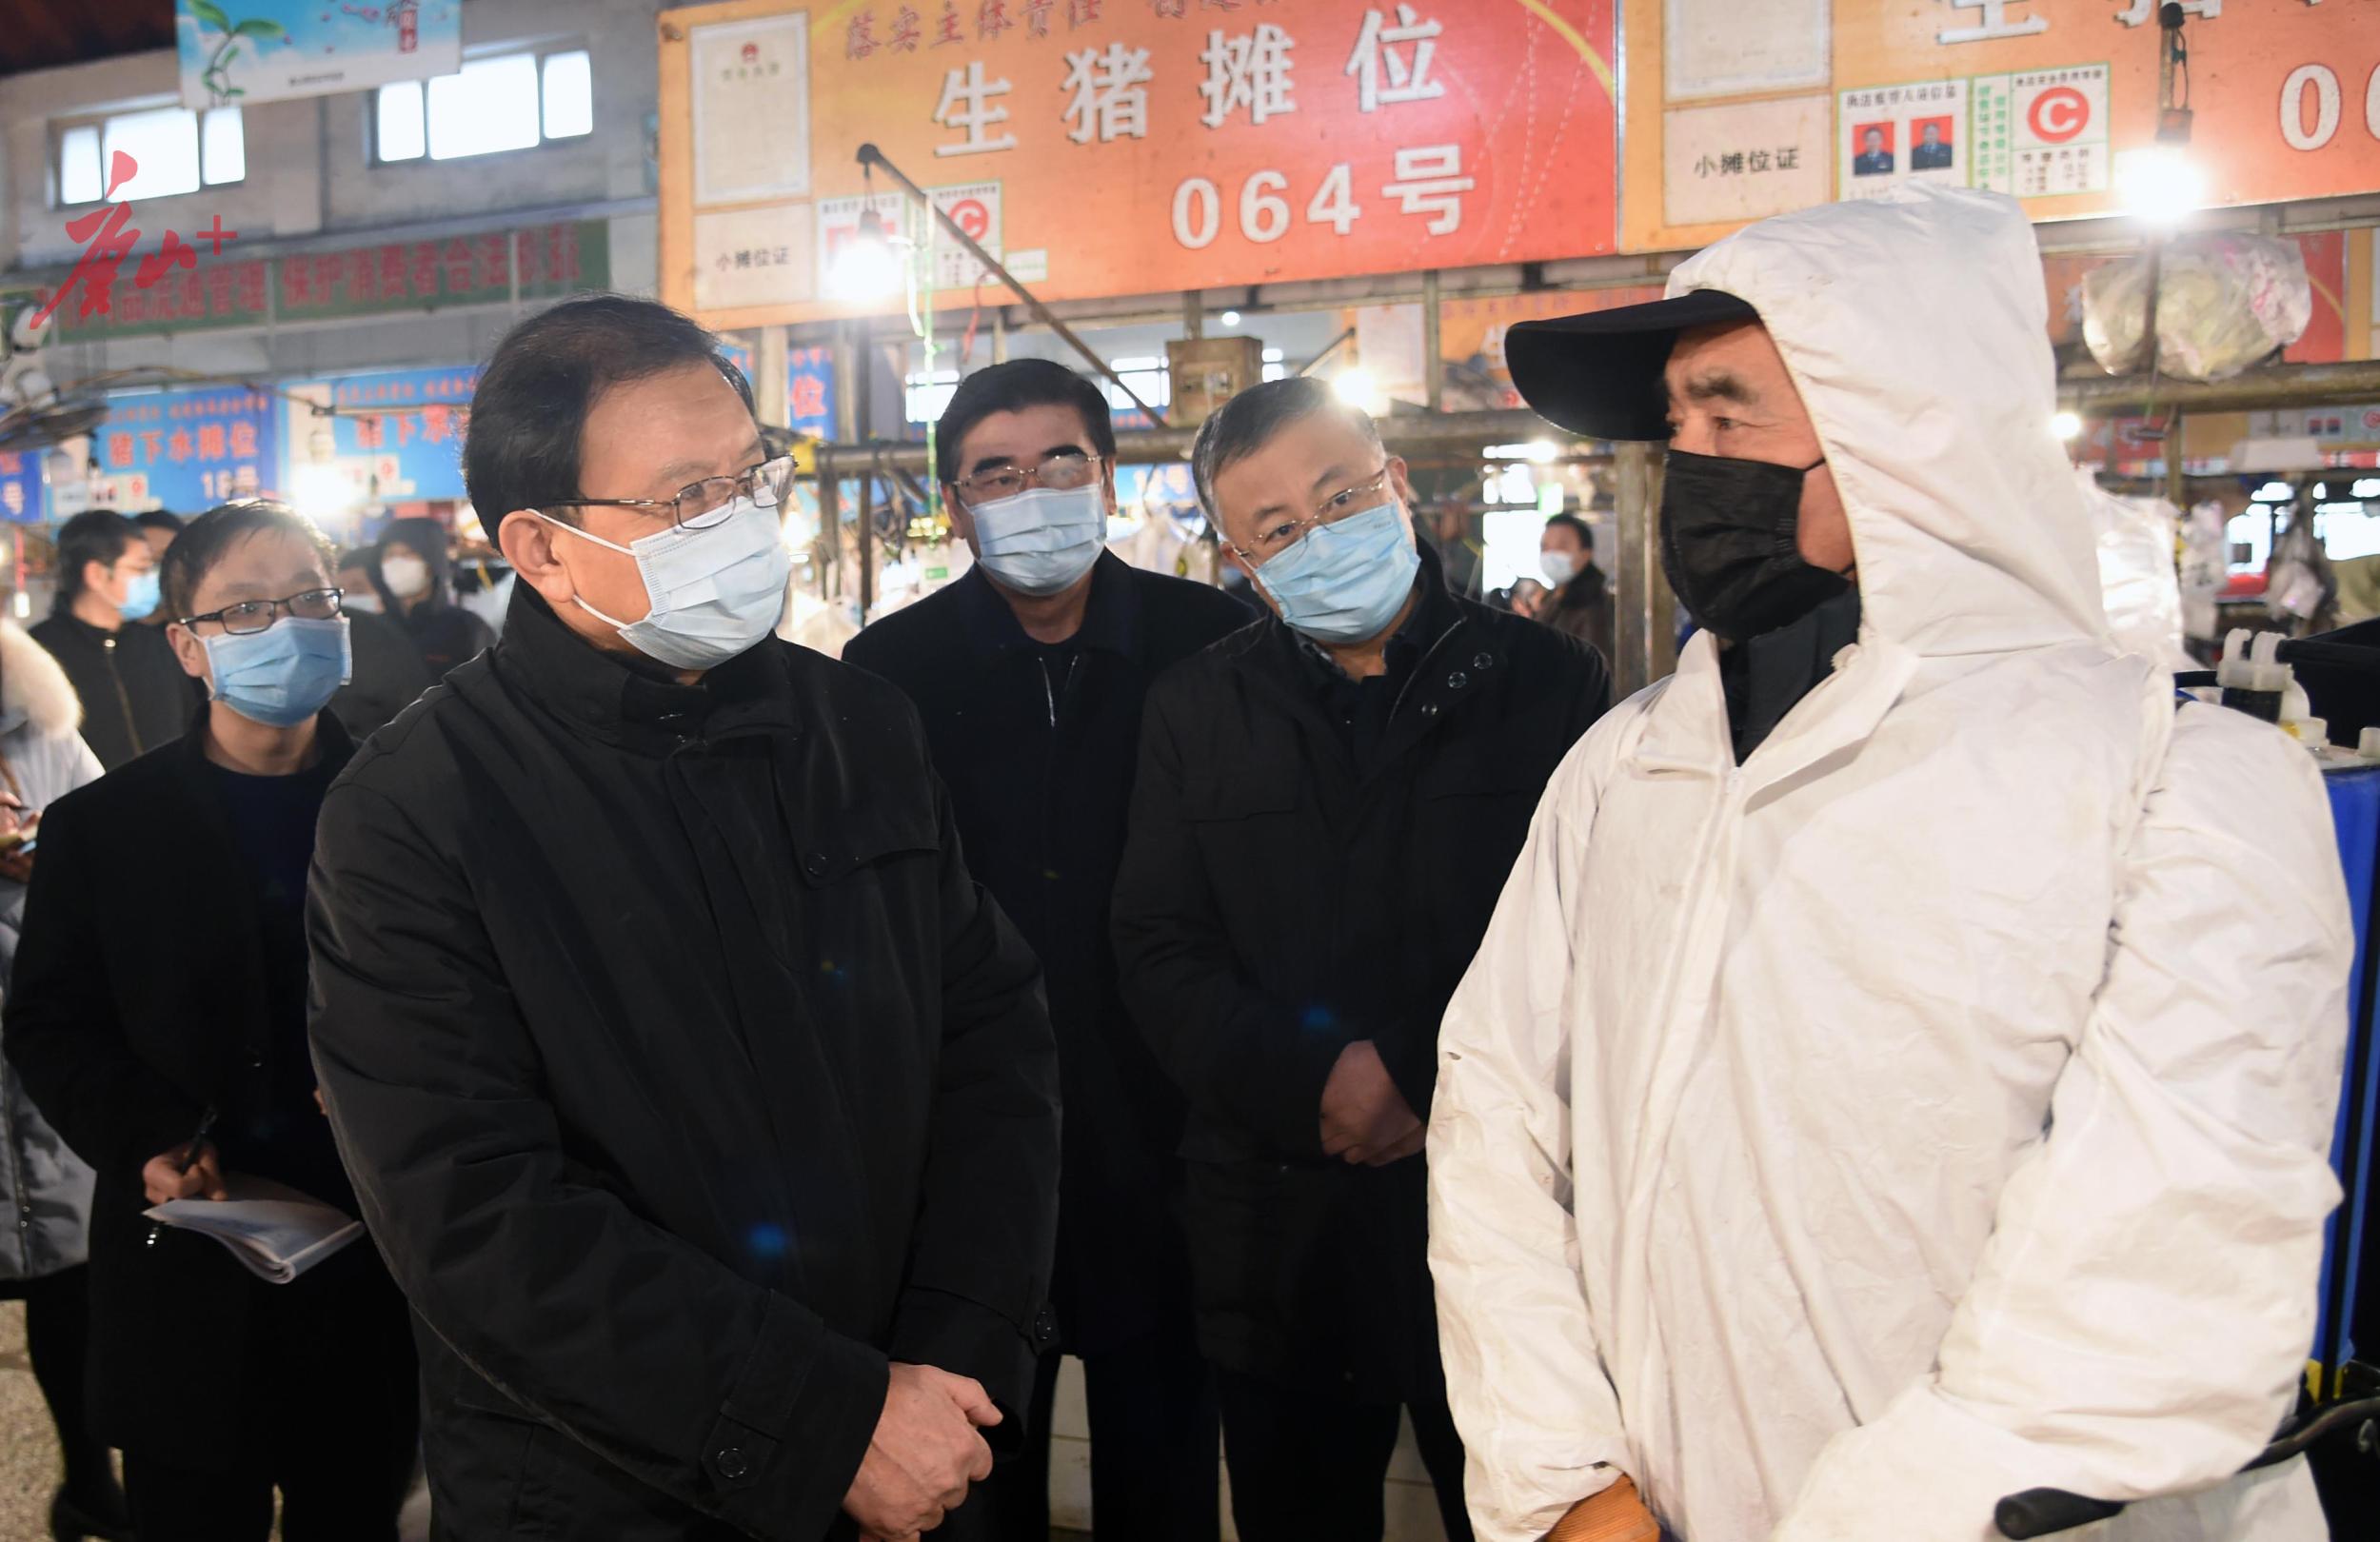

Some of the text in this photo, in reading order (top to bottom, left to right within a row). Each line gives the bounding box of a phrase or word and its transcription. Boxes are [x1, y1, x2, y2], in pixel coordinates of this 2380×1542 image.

[931, 3, 1446, 157] 生猪摊位
[2279, 63, 2380, 152] 0
[1171, 144, 1476, 250] 064号
[1694, 146, 1800, 179] 小摊位证
[715, 246, 791, 273] 小摊位证
